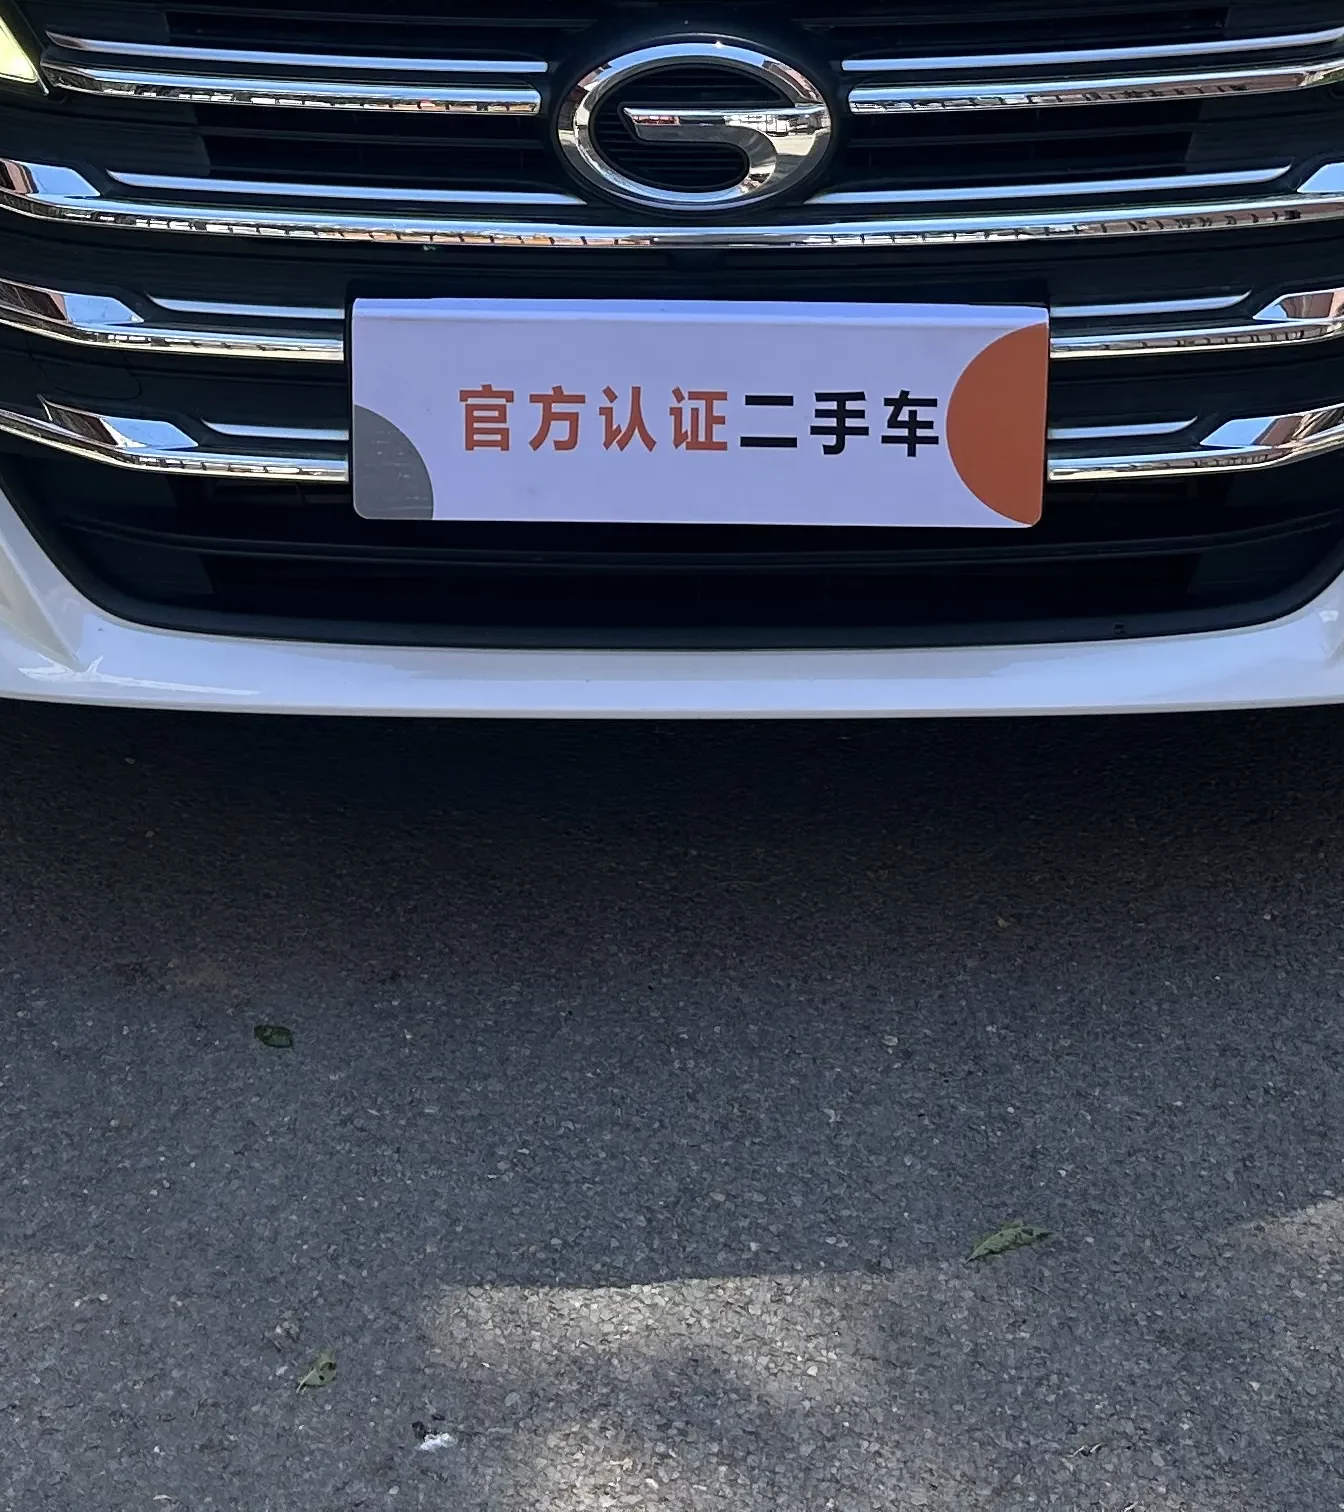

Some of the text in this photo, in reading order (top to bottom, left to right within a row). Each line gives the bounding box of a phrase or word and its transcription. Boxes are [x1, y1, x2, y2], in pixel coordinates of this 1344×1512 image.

[459, 384, 940, 457] 官方认证二手车
